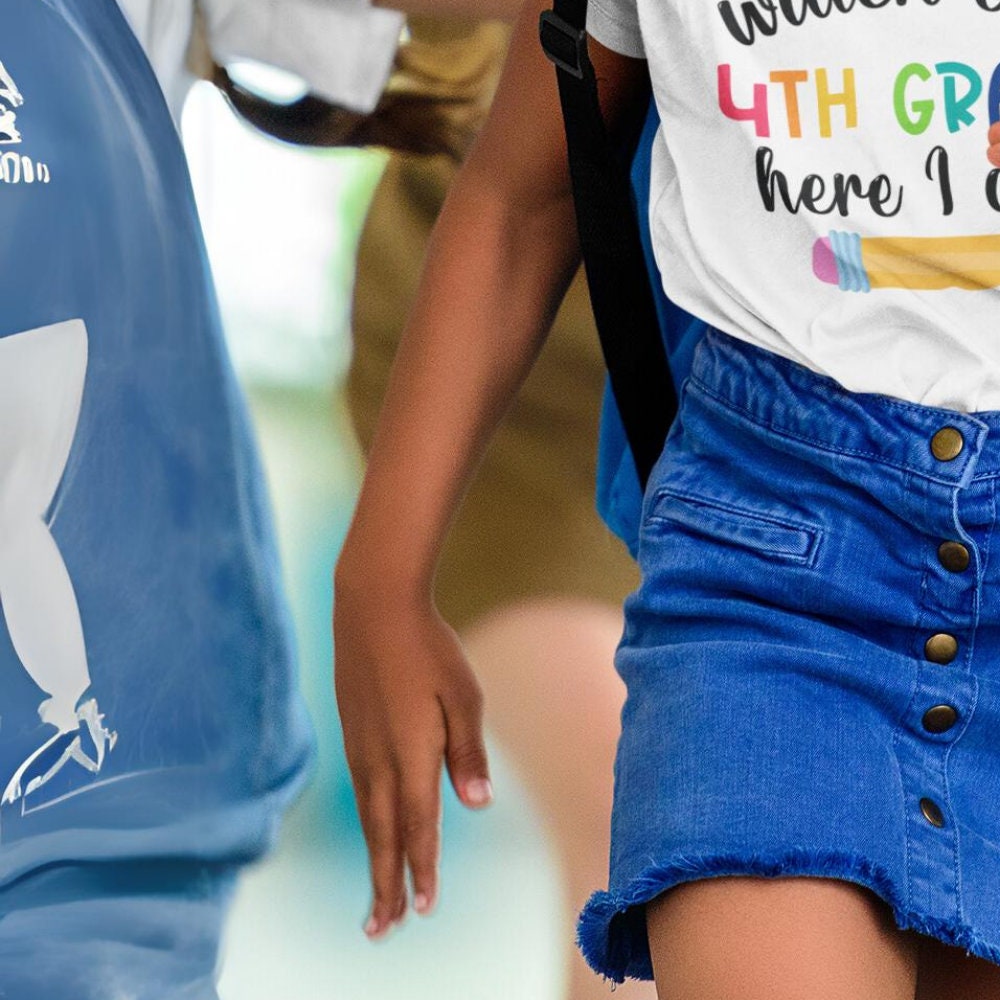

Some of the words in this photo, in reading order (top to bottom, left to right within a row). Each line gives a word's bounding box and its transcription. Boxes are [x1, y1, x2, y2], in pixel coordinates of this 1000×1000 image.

[717, 63, 858, 139] 4TH
[755, 146, 904, 218] here
[925, 145, 954, 216] I
